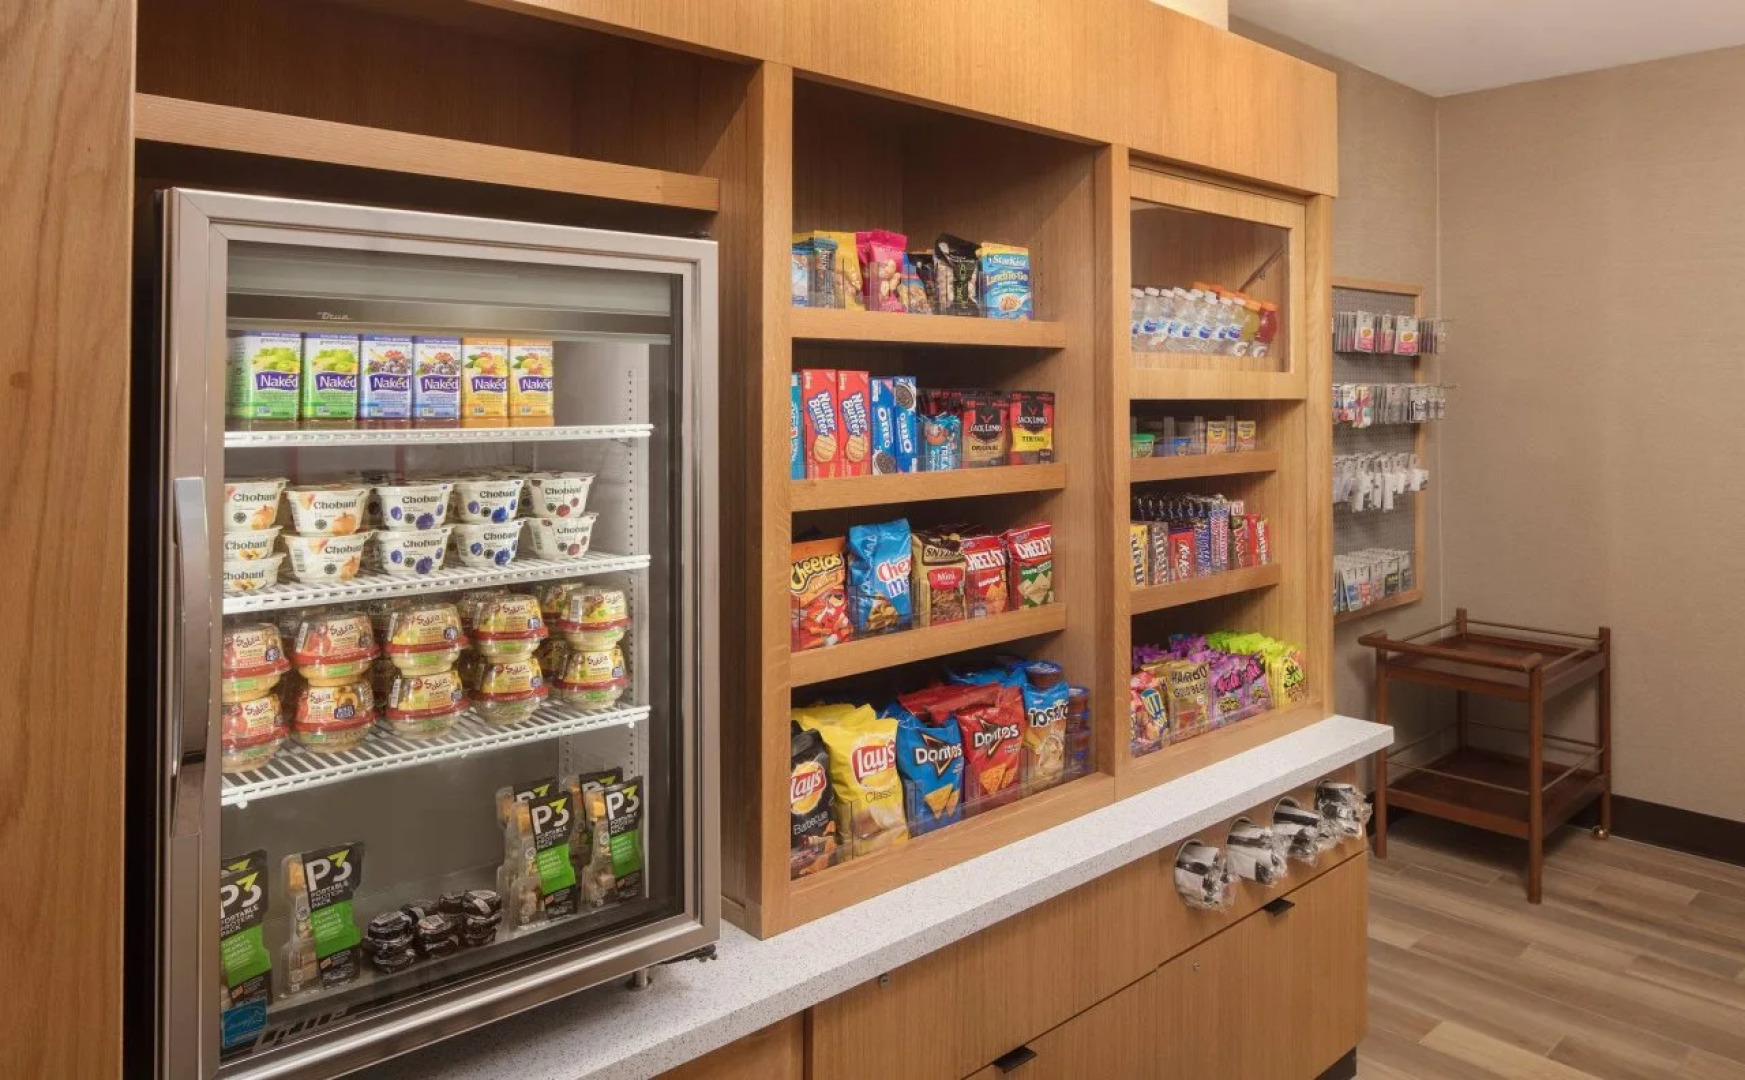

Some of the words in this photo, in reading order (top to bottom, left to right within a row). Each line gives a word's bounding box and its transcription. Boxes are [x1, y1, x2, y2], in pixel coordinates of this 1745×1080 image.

[261, 374, 299, 389] Naked
[320, 375, 358, 389] Naked
[374, 376, 411, 390] Naked
[424, 378, 460, 391] Naked
[475, 379, 507, 391] Naked
[522, 379, 553, 392] Naked
[807, 399, 829, 436] Butter
[817, 391, 837, 431] Nutter
[842, 400, 862, 436] Butter
[851, 392, 868, 431] Nutter
[313, 500, 357, 510] Chobani
[225, 540, 268, 551] Chobani
[791, 554, 842, 591] Cheetos
[937, 571, 956, 581] Mini
[975, 724, 1018, 748] Doritos
[852, 740, 895, 778] Lay's
[916, 742, 962, 765] Doritos
[790, 764, 824, 804] Lay's
[606, 785, 640, 820] P3
[531, 798, 569, 835] P3
[794, 811, 828, 835] Barbecue
[306, 849, 353, 892] P3
[221, 872, 262, 920] P3
